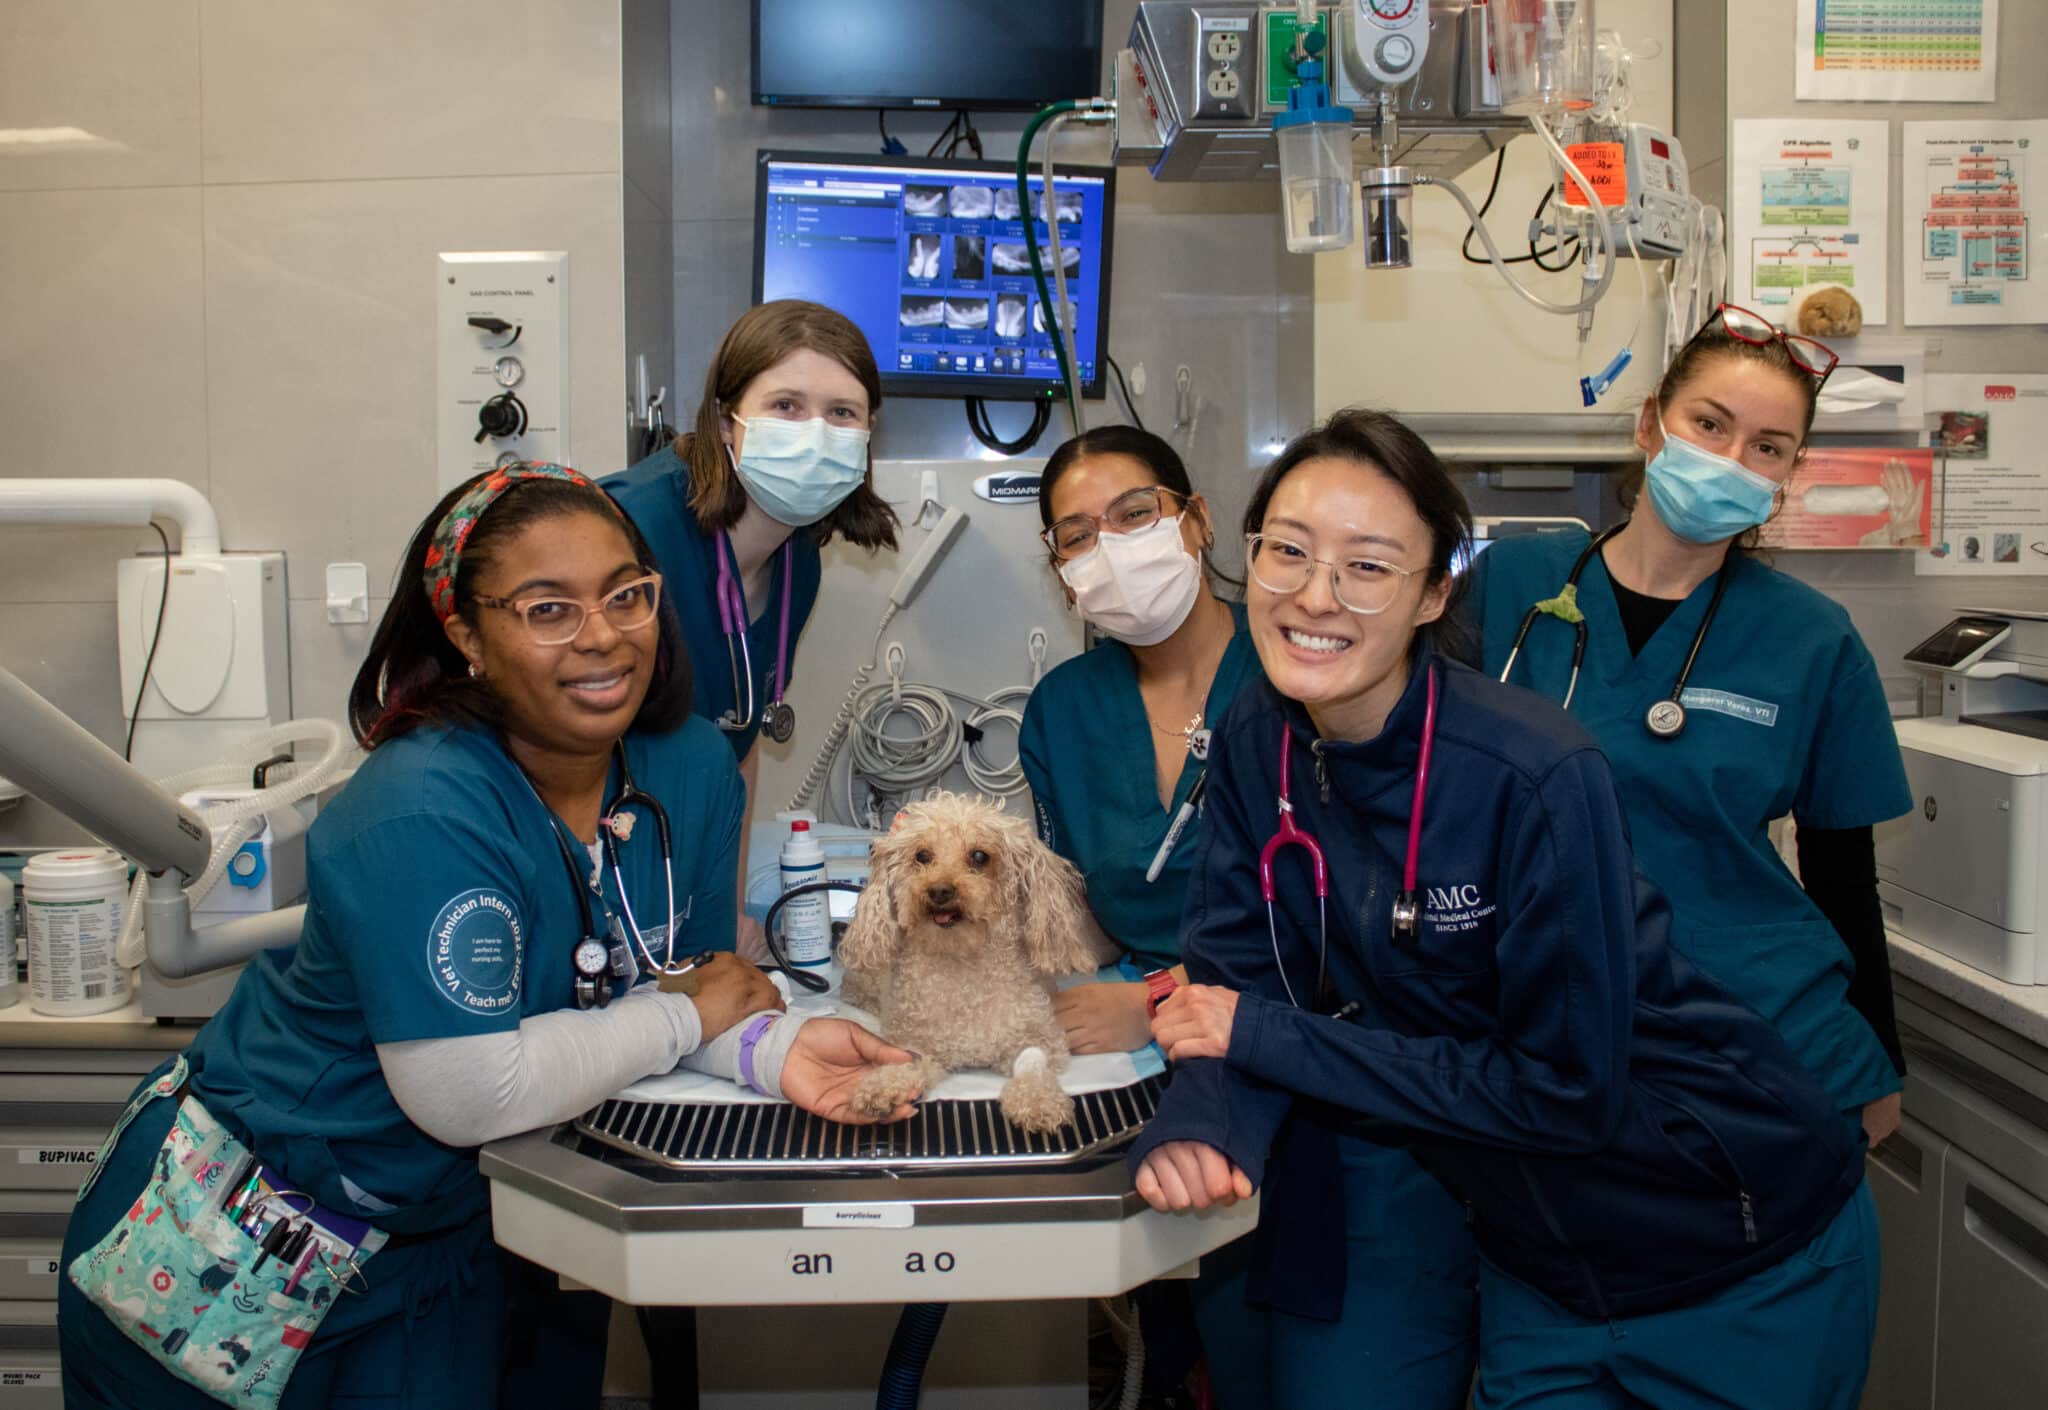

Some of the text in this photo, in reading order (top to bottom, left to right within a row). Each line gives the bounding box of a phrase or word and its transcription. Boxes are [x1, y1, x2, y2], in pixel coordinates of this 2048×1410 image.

[992, 486, 1040, 496] MIDMARK
[479, 894, 513, 919] Intern
[1426, 884, 1481, 910] AMC
[1439, 911, 1471, 922] Medical
[437, 898, 479, 965] Technician
[440, 964, 461, 993] Vet
[463, 990, 497, 1008] Teach
[39, 1151, 95, 1163] BUPIVAC
[792, 1254, 832, 1275] an
